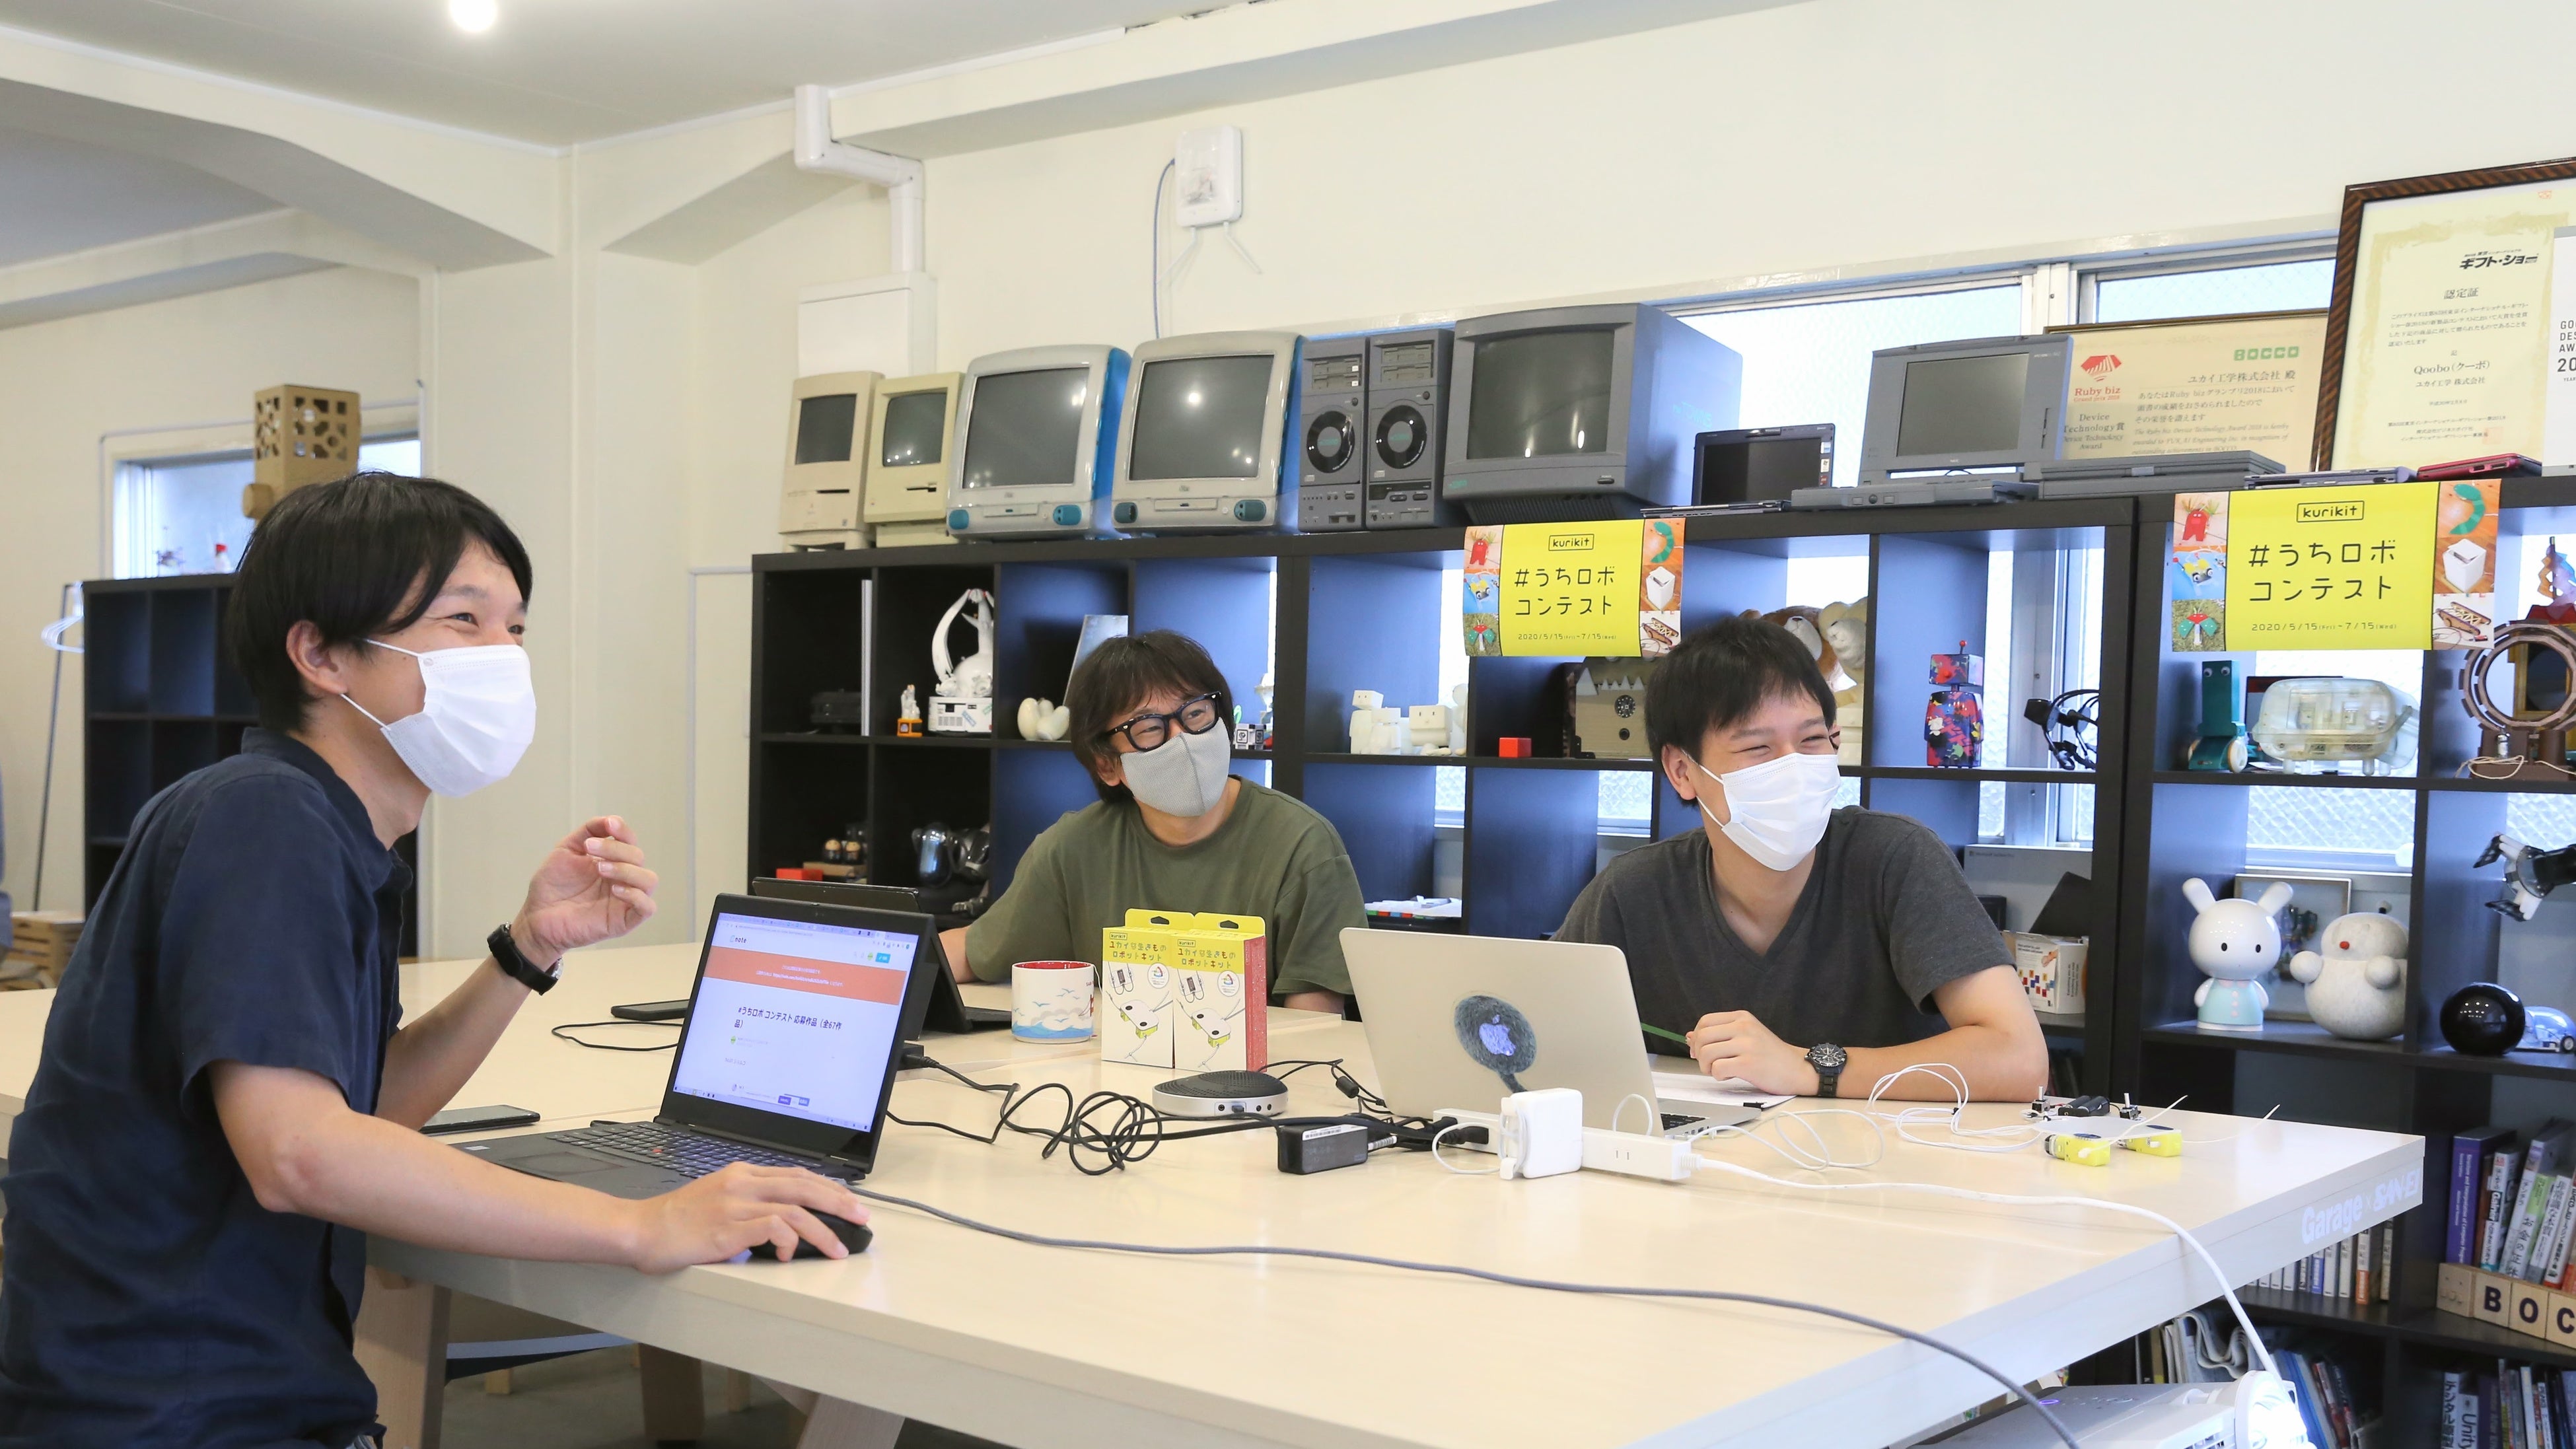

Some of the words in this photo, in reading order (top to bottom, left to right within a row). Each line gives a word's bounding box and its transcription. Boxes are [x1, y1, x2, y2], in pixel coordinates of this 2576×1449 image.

[2459, 254, 2538, 269] ギフト・ショー
[2443, 287, 2479, 300] 認定証
[2560, 320, 2576, 330] GO
[2233, 346, 2300, 361] BOCCO
[2559, 343, 2576, 353] AW
[2188, 371, 2281, 384] ユカイ工学株式会社
[2075, 387, 2102, 397] Ruby
[2303, 505, 2357, 518] kurikit
[1553, 538, 1590, 548] kurikit
[2249, 540, 2396, 567] #うちロボ
[1515, 567, 1615, 587] #うちロボ
[2250, 576, 2391, 601] コンテスト
[1515, 595, 1612, 615] コンテスト
[1112, 951, 1163, 962] ロボットキット
[1182, 958, 1232, 969] ロボットキット
[738, 1007, 764, 1018] #うちロボ
[765, 1010, 793, 1022] コンテスト
[2301, 1193, 2363, 1245] Garage
[2458, 1413, 2477, 1449] Unity
